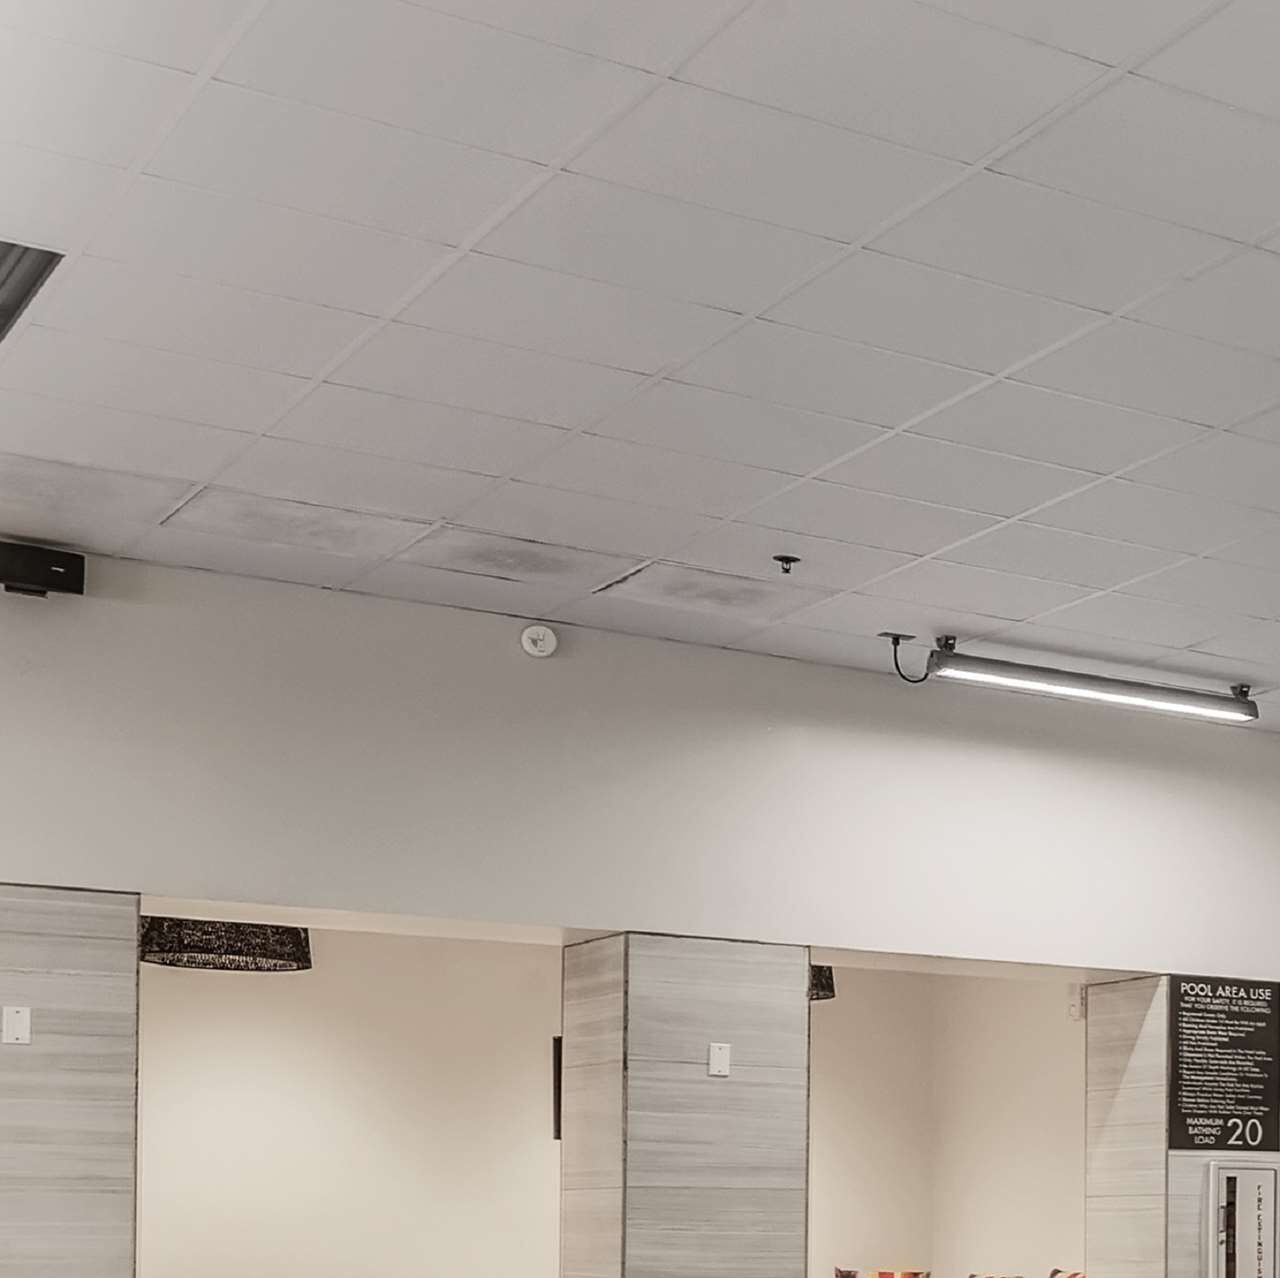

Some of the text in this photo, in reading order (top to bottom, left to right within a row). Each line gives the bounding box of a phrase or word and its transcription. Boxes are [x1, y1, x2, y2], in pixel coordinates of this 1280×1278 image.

[1181, 982, 1272, 1000] POOL AREA USE
[1186, 1117, 1224, 1126] MAXIMUM
[1188, 1118, 1263, 1146] BATHING 20
[1194, 1135, 1216, 1144] LOAD
